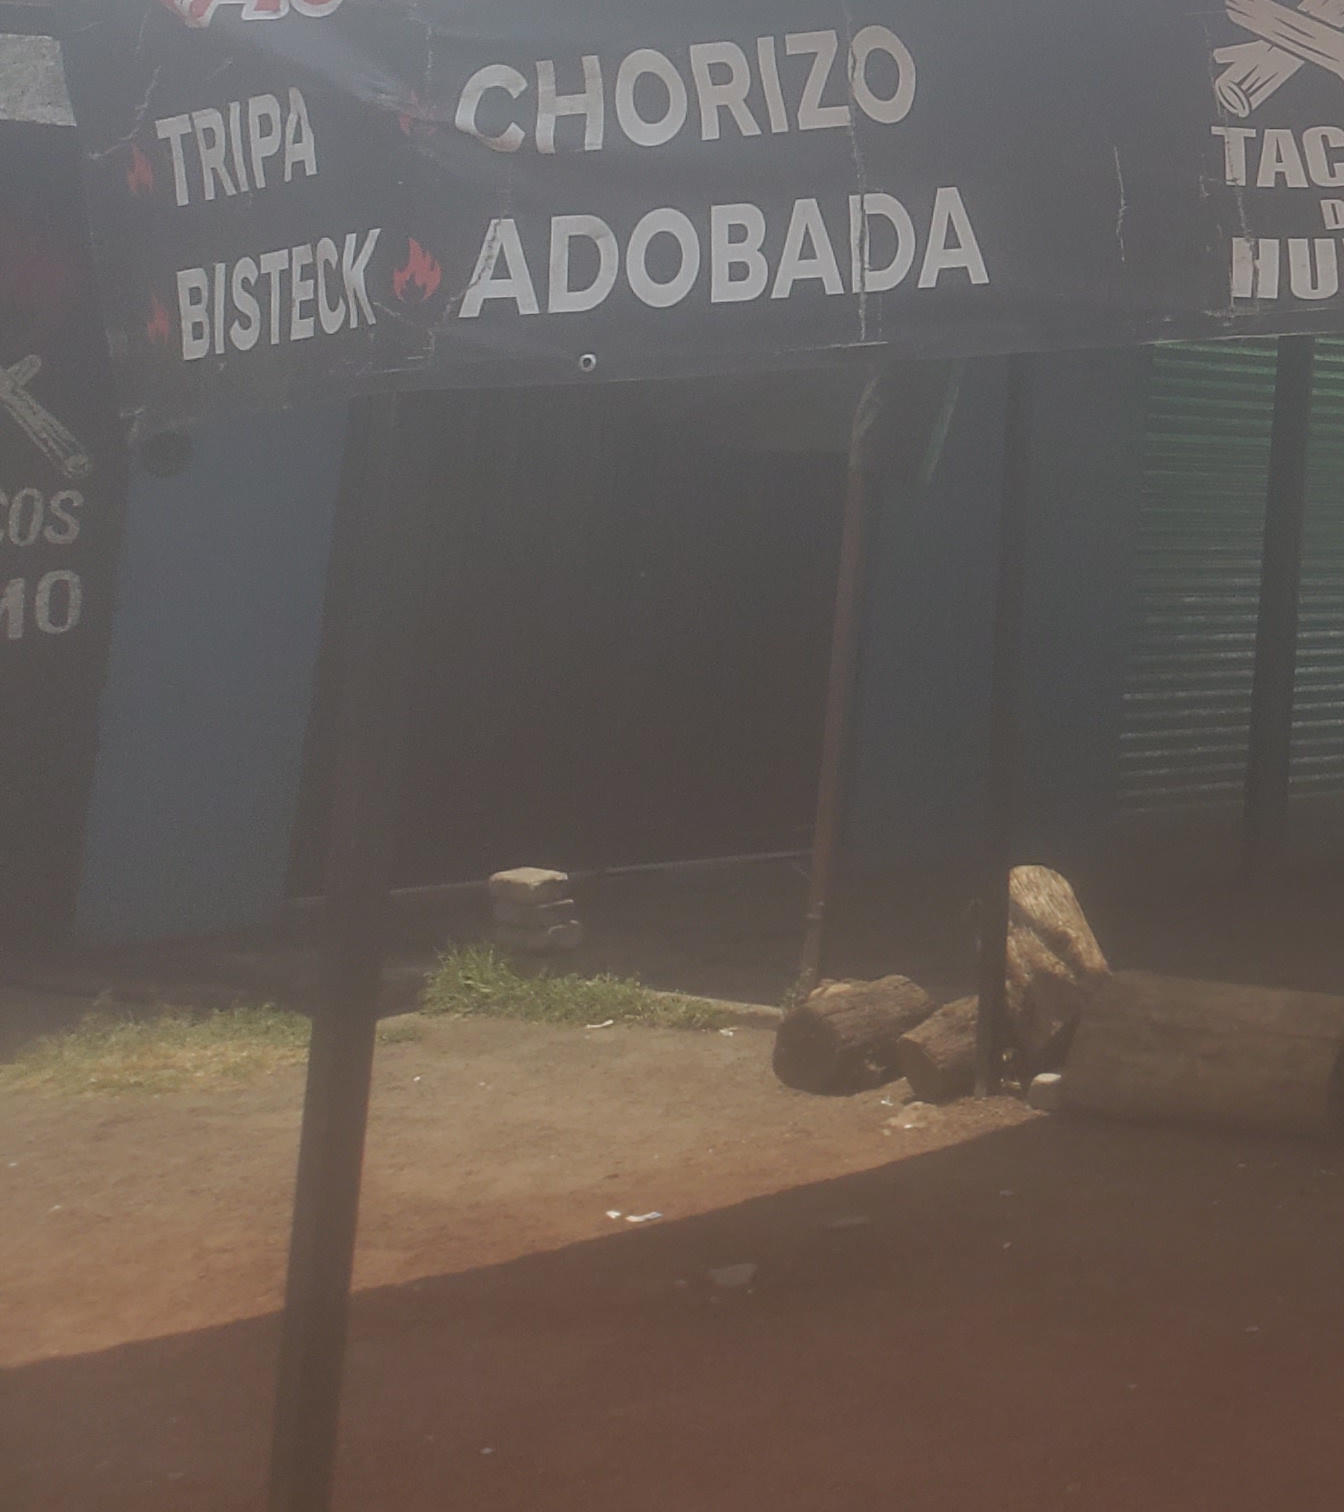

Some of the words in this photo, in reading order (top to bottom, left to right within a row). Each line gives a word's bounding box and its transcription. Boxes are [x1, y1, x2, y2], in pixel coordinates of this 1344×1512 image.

[155, 88, 319, 207] TRIPA
[454, 25, 917, 154] CHORIZO
[176, 227, 381, 361] BISTECK
[458, 186, 990, 318] ADOBADA
[0, 488, 84, 548] OS
